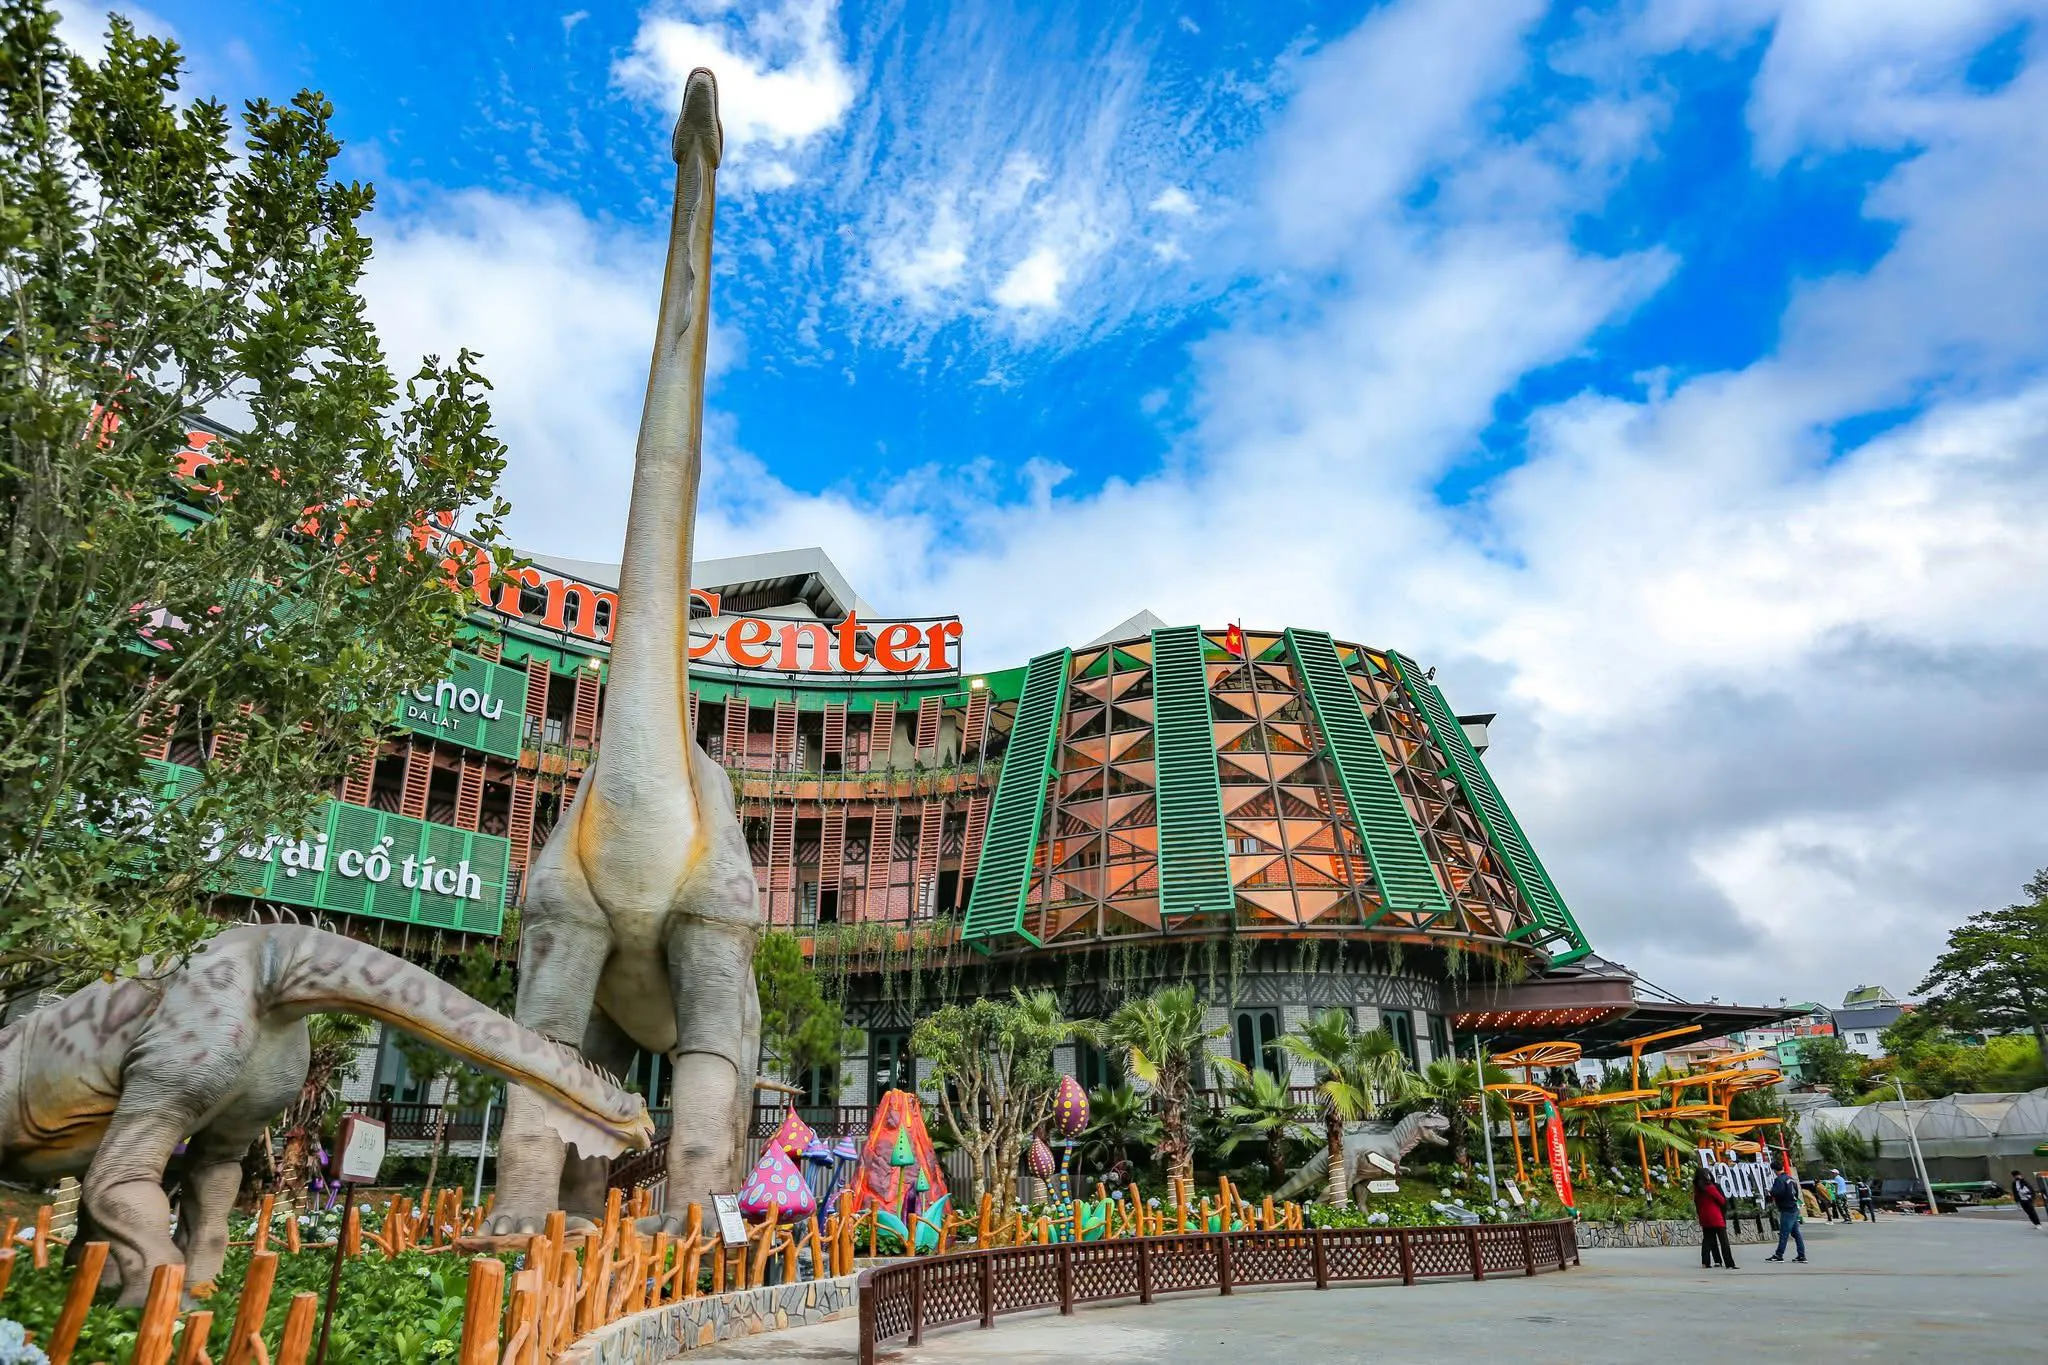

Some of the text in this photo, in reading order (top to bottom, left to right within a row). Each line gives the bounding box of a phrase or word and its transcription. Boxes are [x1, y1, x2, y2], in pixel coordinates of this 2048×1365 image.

[407, 705, 461, 730] DALAT
[337, 835, 395, 883] cổ
[400, 853, 482, 900] tích
